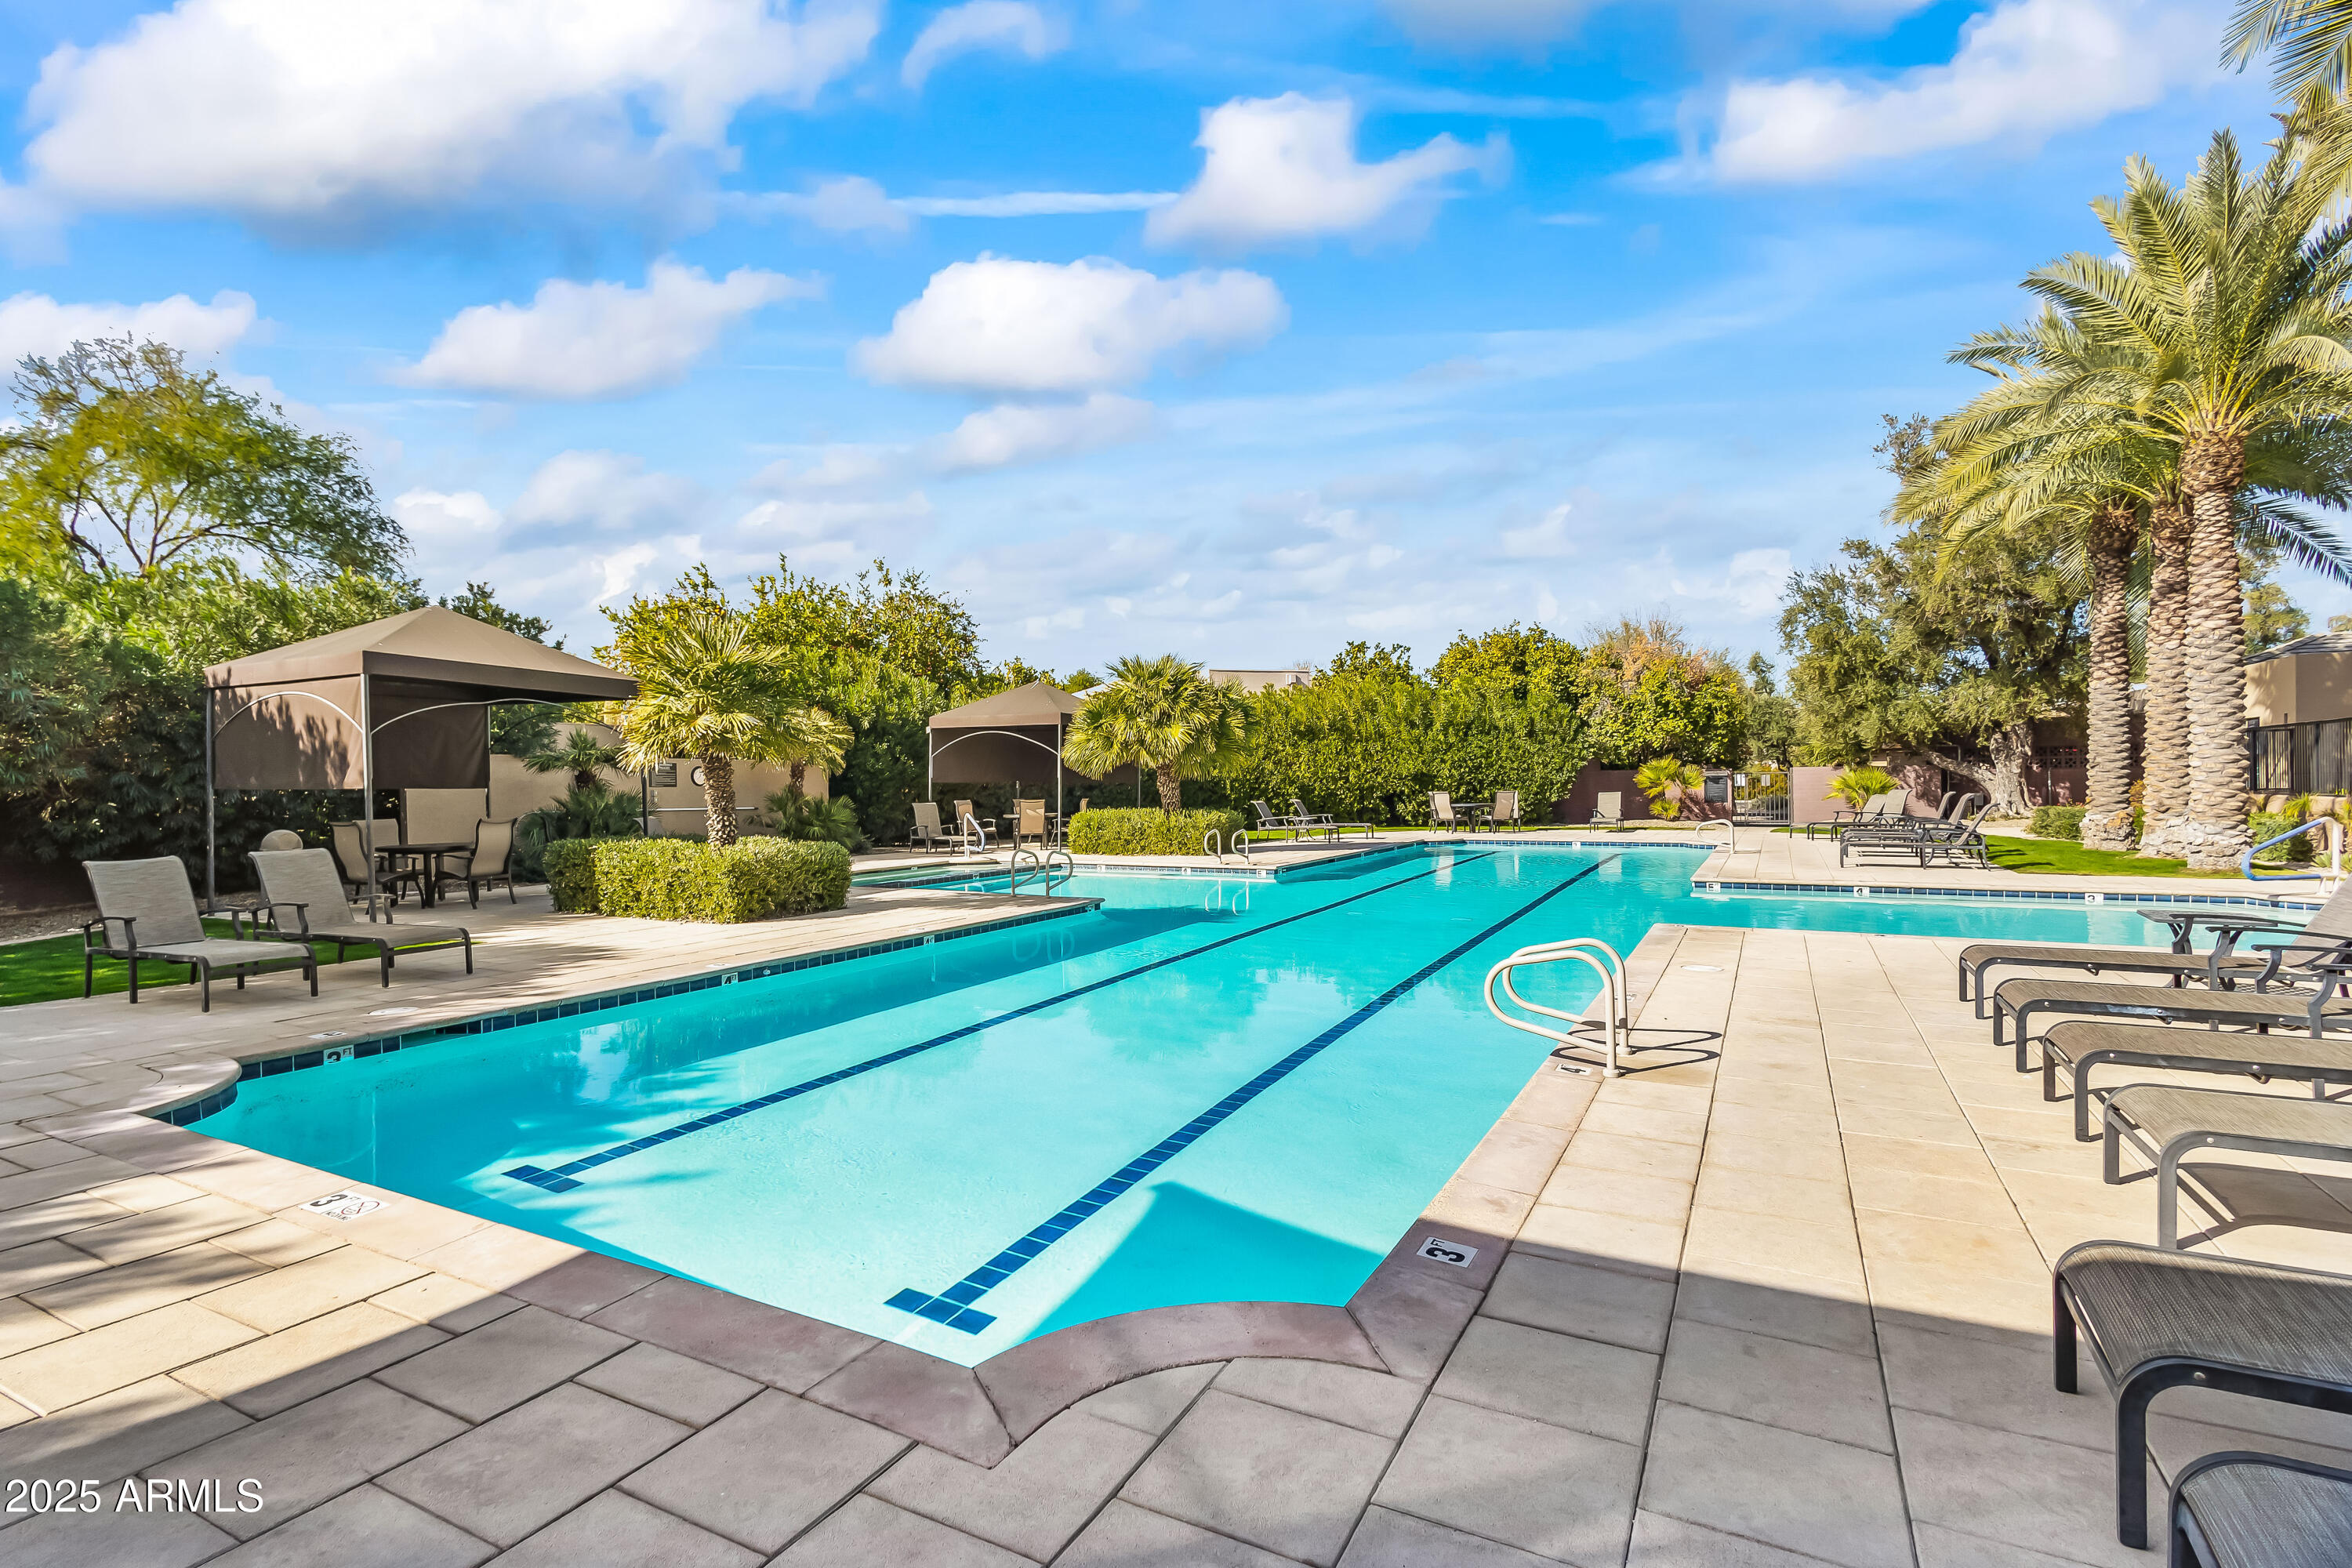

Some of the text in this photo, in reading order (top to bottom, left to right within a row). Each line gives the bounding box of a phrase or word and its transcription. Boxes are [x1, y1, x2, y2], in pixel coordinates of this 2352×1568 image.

[2087, 895, 2096, 903] 3
[327, 1047, 353, 1064] 3 FT
[309, 1194, 348, 1207] 3
[1425, 1238, 1466, 1263] 3 FT
